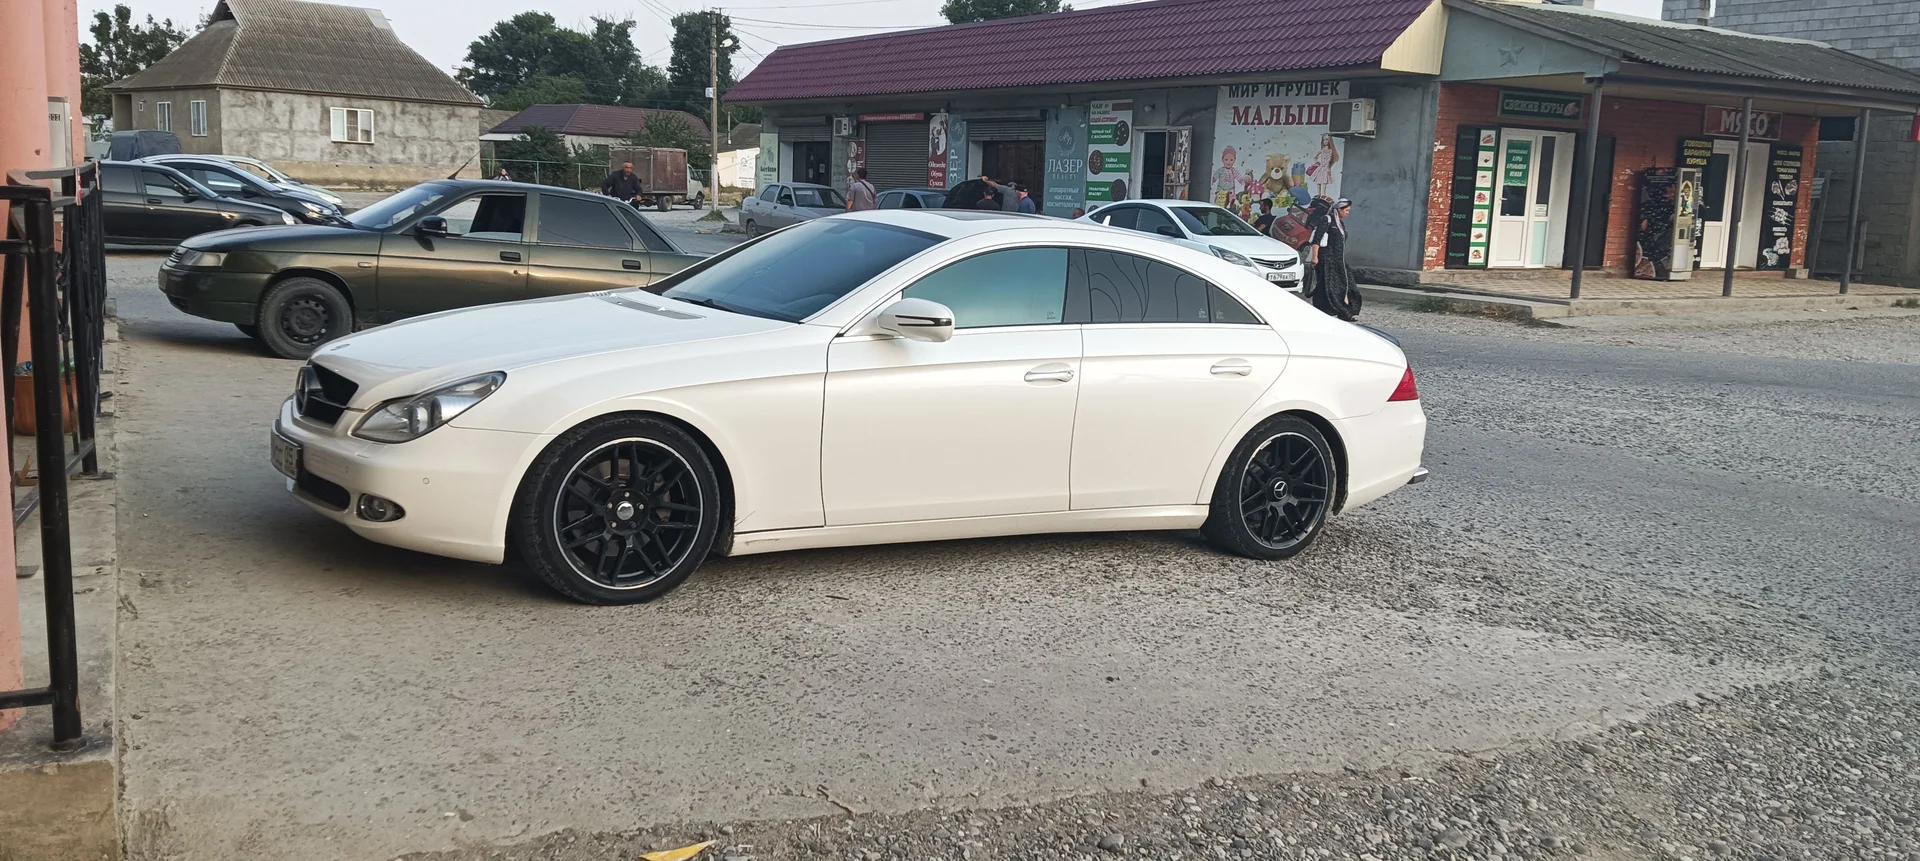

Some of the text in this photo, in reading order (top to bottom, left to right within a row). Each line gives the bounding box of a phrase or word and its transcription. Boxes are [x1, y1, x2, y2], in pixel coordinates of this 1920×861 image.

[1228, 81, 1340, 98] МИР ИГРУШЕК
[1503, 99, 1564, 114] СВЕЖИЕ КУРЫ
[1231, 104, 1330, 126] МАЛЫШ
[949, 149, 958, 184] ЗЕР
[1047, 158, 1083, 173] ЛАЗЕР
[1686, 157, 1707, 166] КУРИЦА
